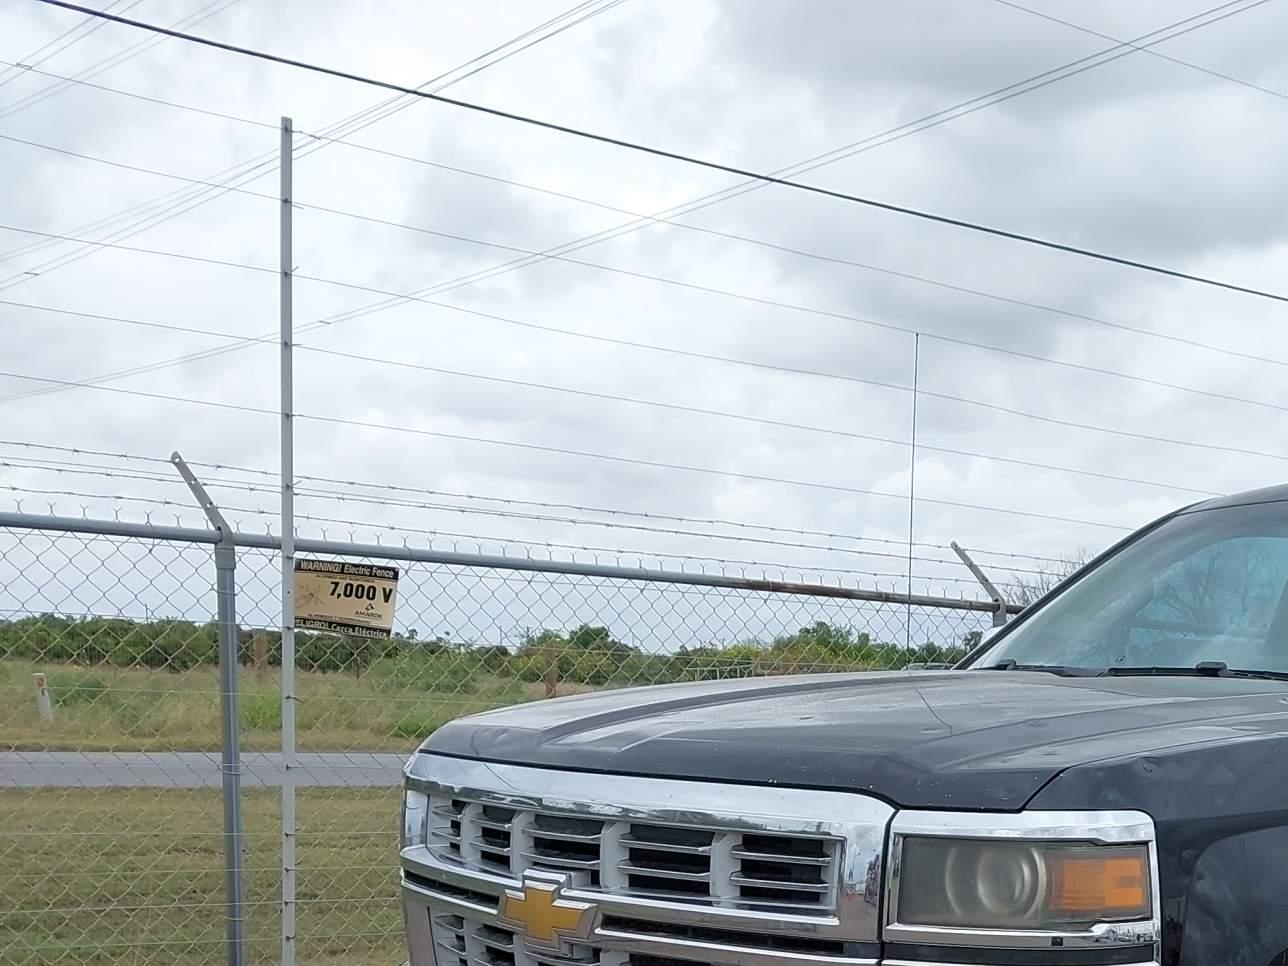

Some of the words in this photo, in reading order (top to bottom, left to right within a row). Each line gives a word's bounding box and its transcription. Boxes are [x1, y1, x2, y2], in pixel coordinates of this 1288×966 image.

[300, 560, 342, 573] WARNING!
[343, 564, 370, 575] Electric
[371, 567, 394, 578] Fence
[329, 581, 377, 601] 7,000
[382, 587, 393, 603] V
[295, 619, 329, 630] ELIGRO!
